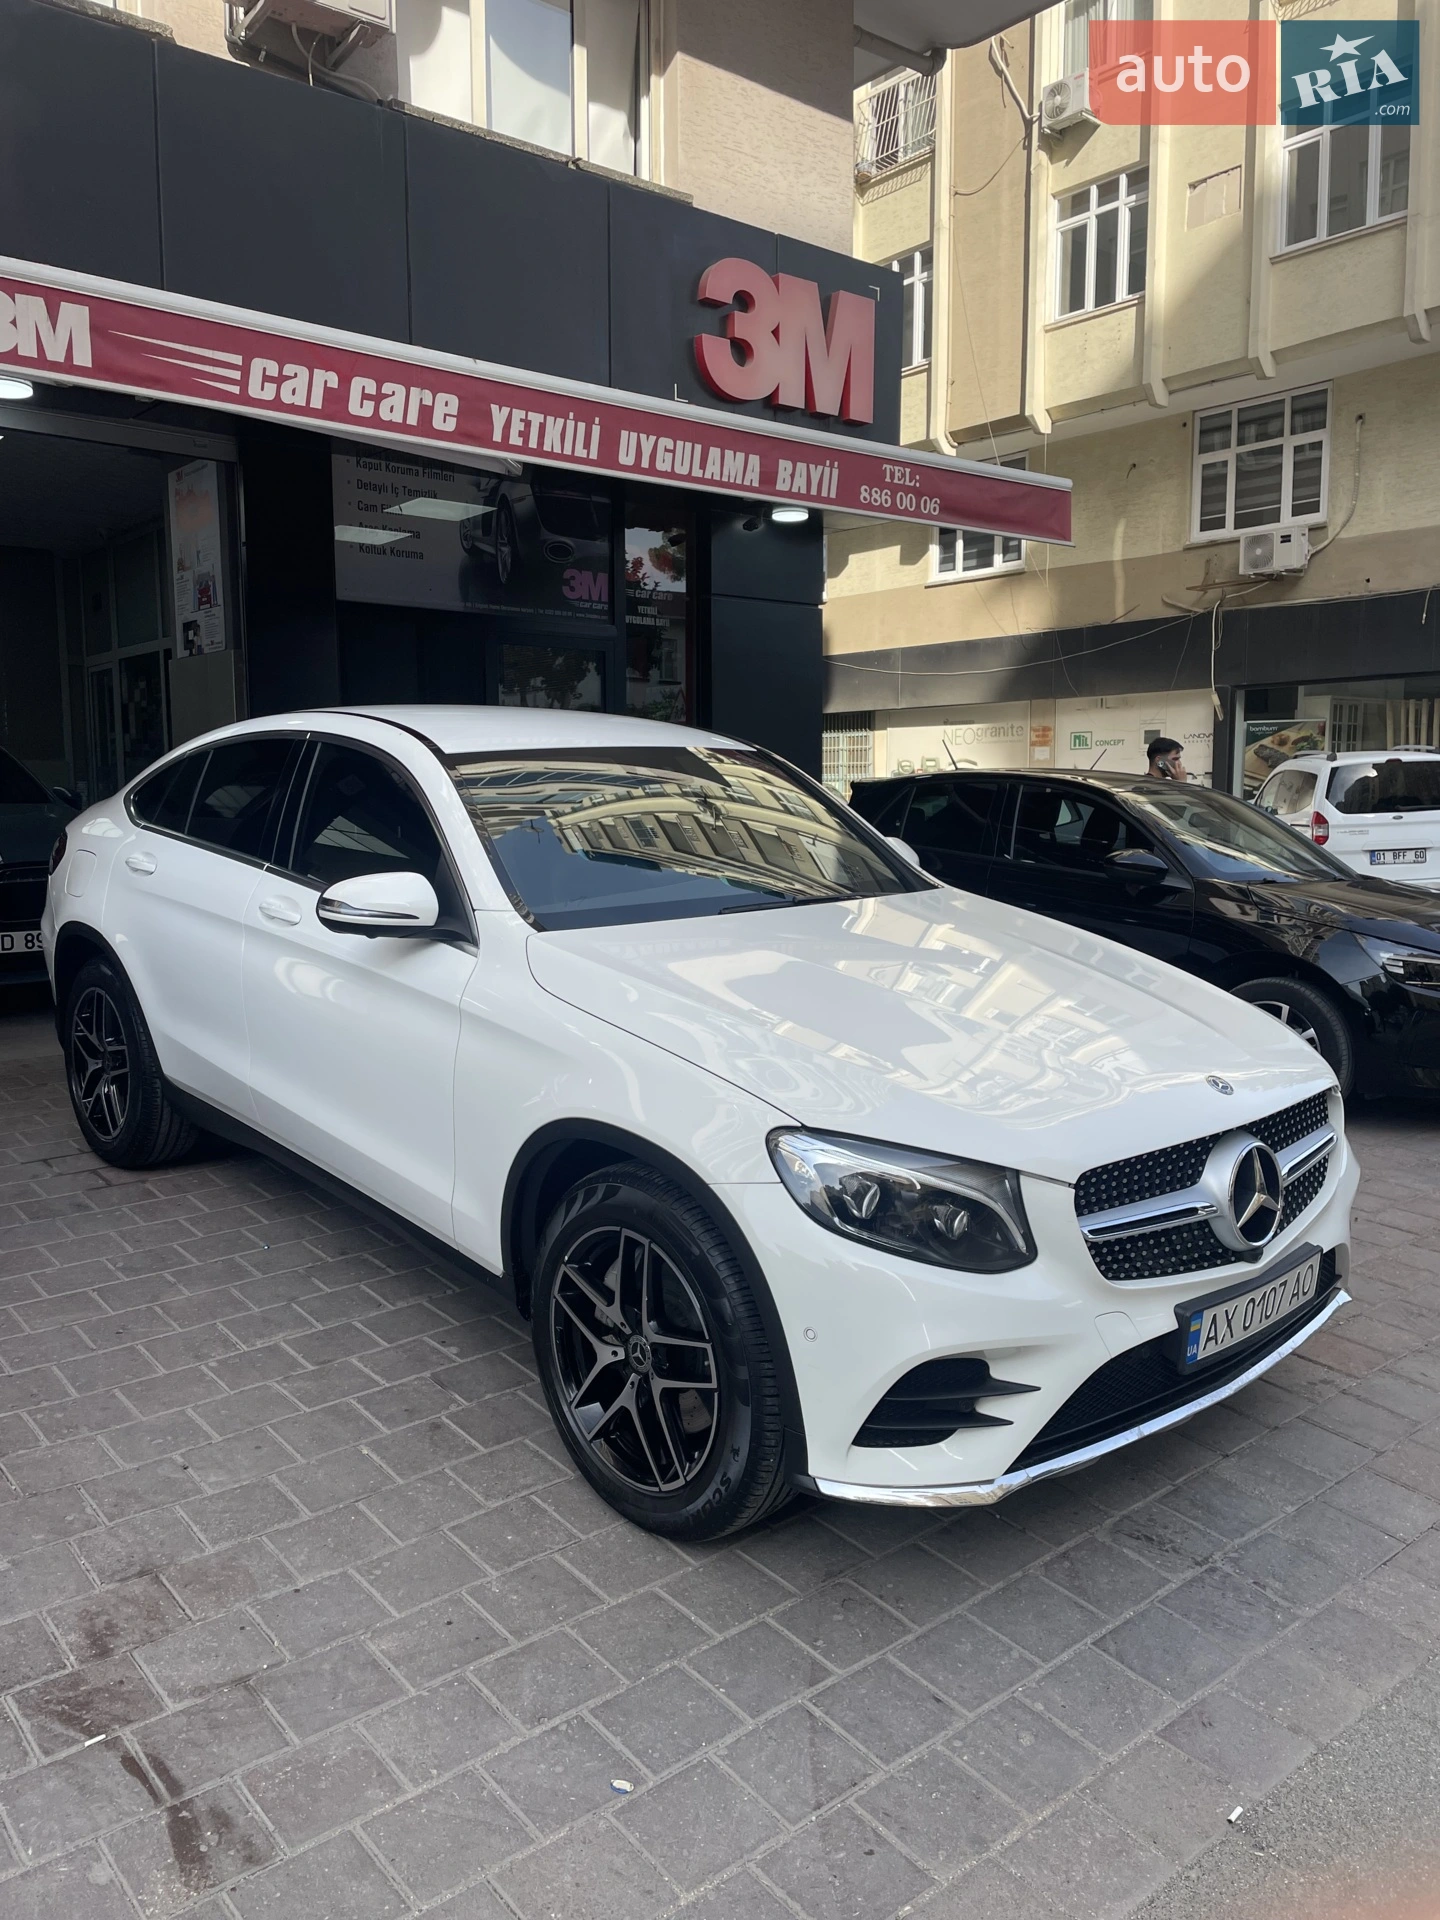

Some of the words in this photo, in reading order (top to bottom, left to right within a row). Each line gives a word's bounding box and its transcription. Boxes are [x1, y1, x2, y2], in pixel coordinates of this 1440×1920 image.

[694, 257, 877, 426] 3M
[247, 357, 338, 409] car
[348, 377, 459, 433] care
[490, 403, 601, 461] YETKİLİ
[619, 431, 760, 488] UYGULAMA
[776, 459, 839, 499] BAYİİ
[355, 457, 382, 472] Kaput
[385, 462, 419, 477] Koruma
[422, 467, 455, 482] Filmleri
[882, 464, 920, 487] TEL:
[357, 479, 388, 495] Detaylı
[391, 483, 399, 498] İç
[357, 500, 378, 513] Cam
[859, 486, 891, 508] 886
[896, 492, 916, 512] 00
[919, 495, 941, 516] 06
[359, 543, 387, 556] Koltuk
[390, 547, 424, 560] Koruma
[562, 568, 608, 602] 3M
[635, 589, 652, 599] car
[652, 591, 673, 601] care
[1095, 739, 1125, 747] CONCEPT
[1376, 852, 1386, 861] 01
[1392, 851, 1407, 860] BFF
[1414, 850, 1425, 859] 60
[1202, 1304, 1238, 1351] AX
[1242, 1278, 1288, 1332] 0107
[1288, 1263, 1314, 1306] AO
[1187, 1344, 1198, 1357] UA
